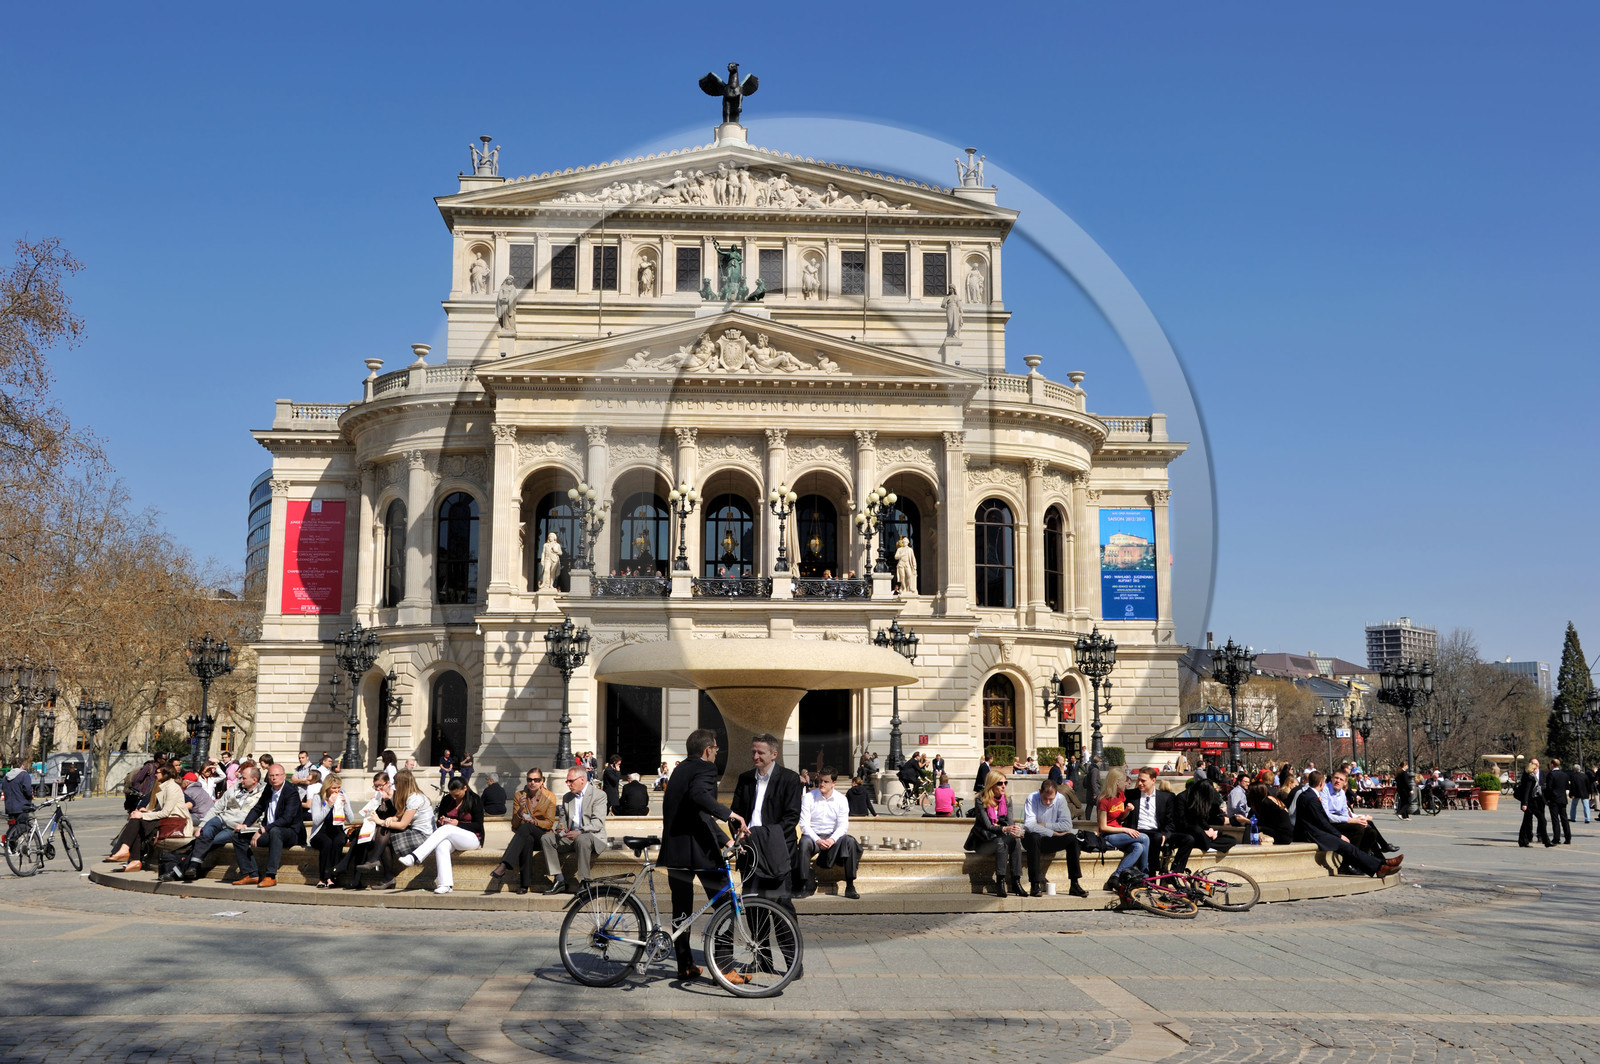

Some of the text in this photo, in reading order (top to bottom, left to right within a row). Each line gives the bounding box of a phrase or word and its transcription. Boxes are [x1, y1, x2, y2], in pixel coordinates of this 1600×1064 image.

[594, 398, 628, 409] DEM
[637, 398, 705, 411] WAHREN
[716, 399, 800, 412] SCHOENEN
